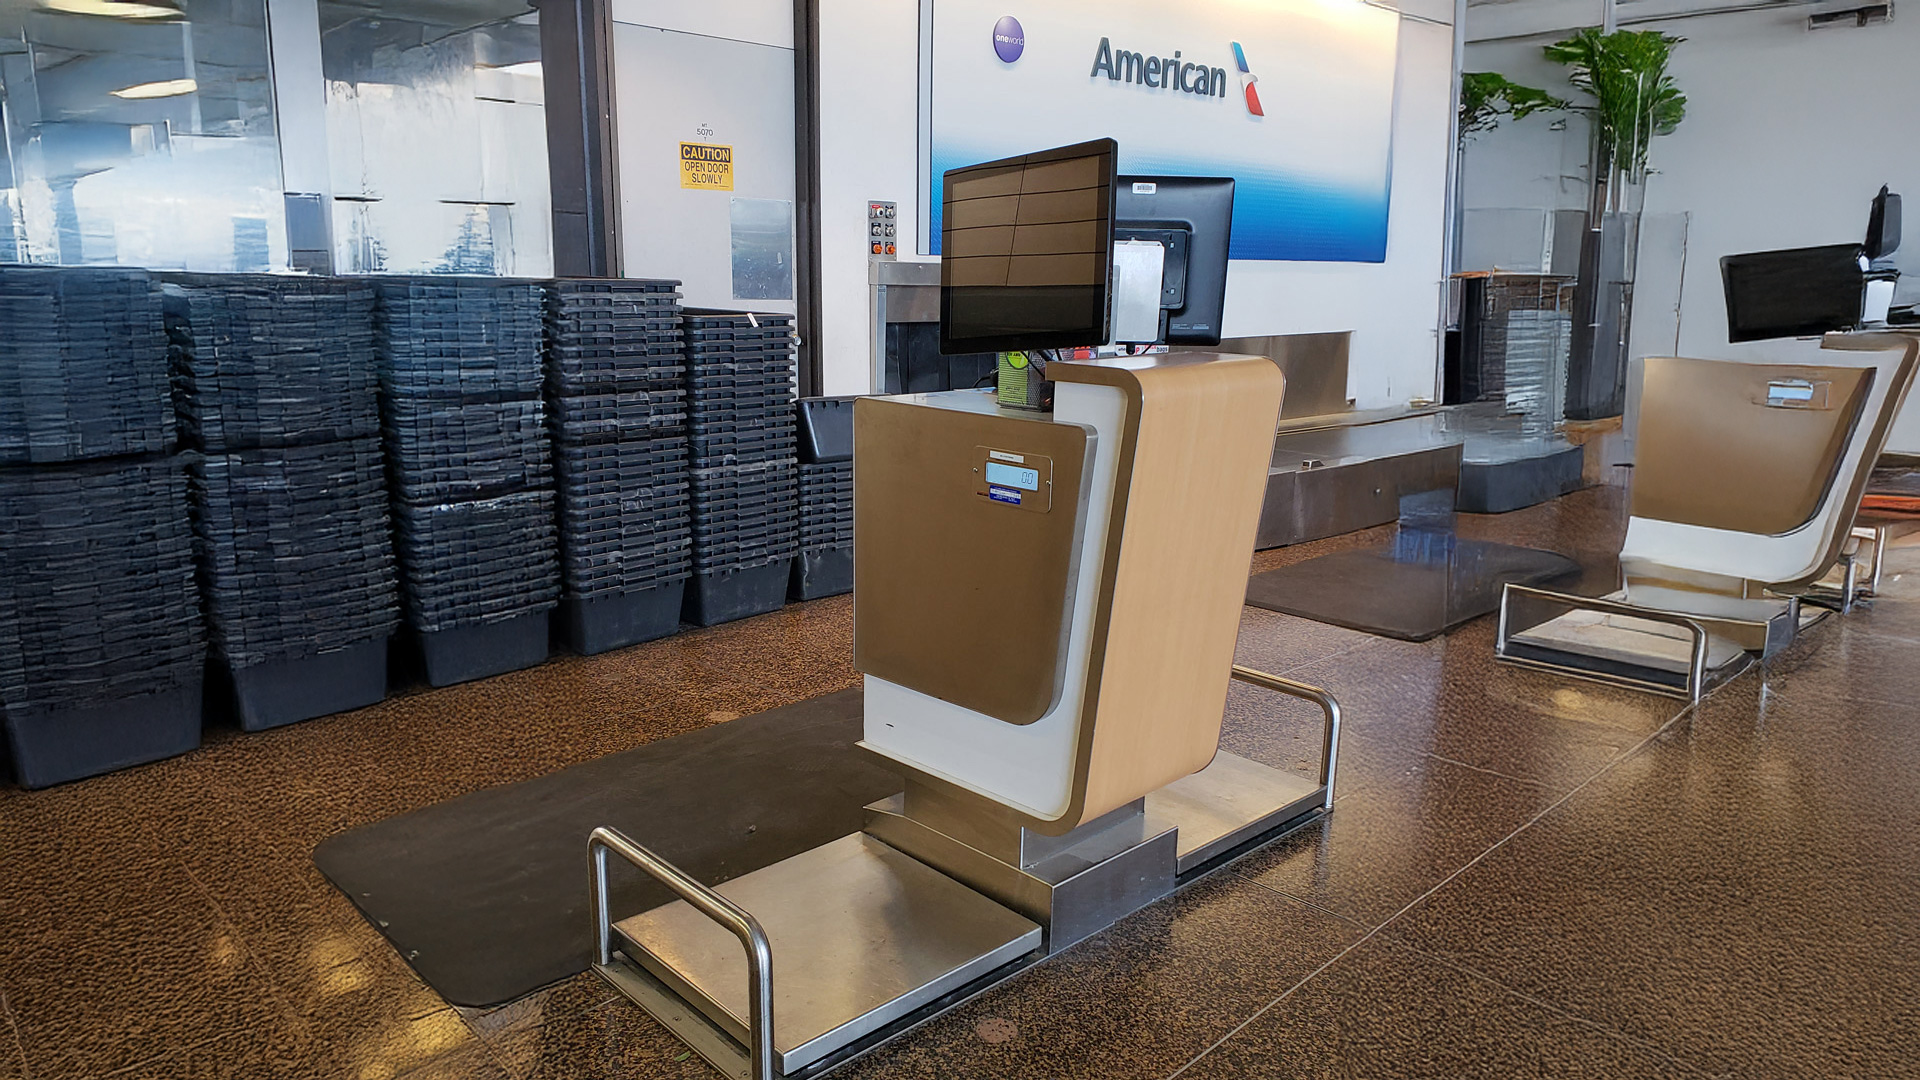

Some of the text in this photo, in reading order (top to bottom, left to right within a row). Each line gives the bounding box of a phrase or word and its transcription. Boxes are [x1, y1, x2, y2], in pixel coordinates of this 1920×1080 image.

[995, 33, 1024, 46] oneworld
[1090, 36, 1227, 98] American
[696, 128, 714, 137] 5070
[682, 146, 730, 161] CAUTION
[684, 161, 729, 174] OPEN DOOR
[691, 172, 723, 184] SLOWLY
